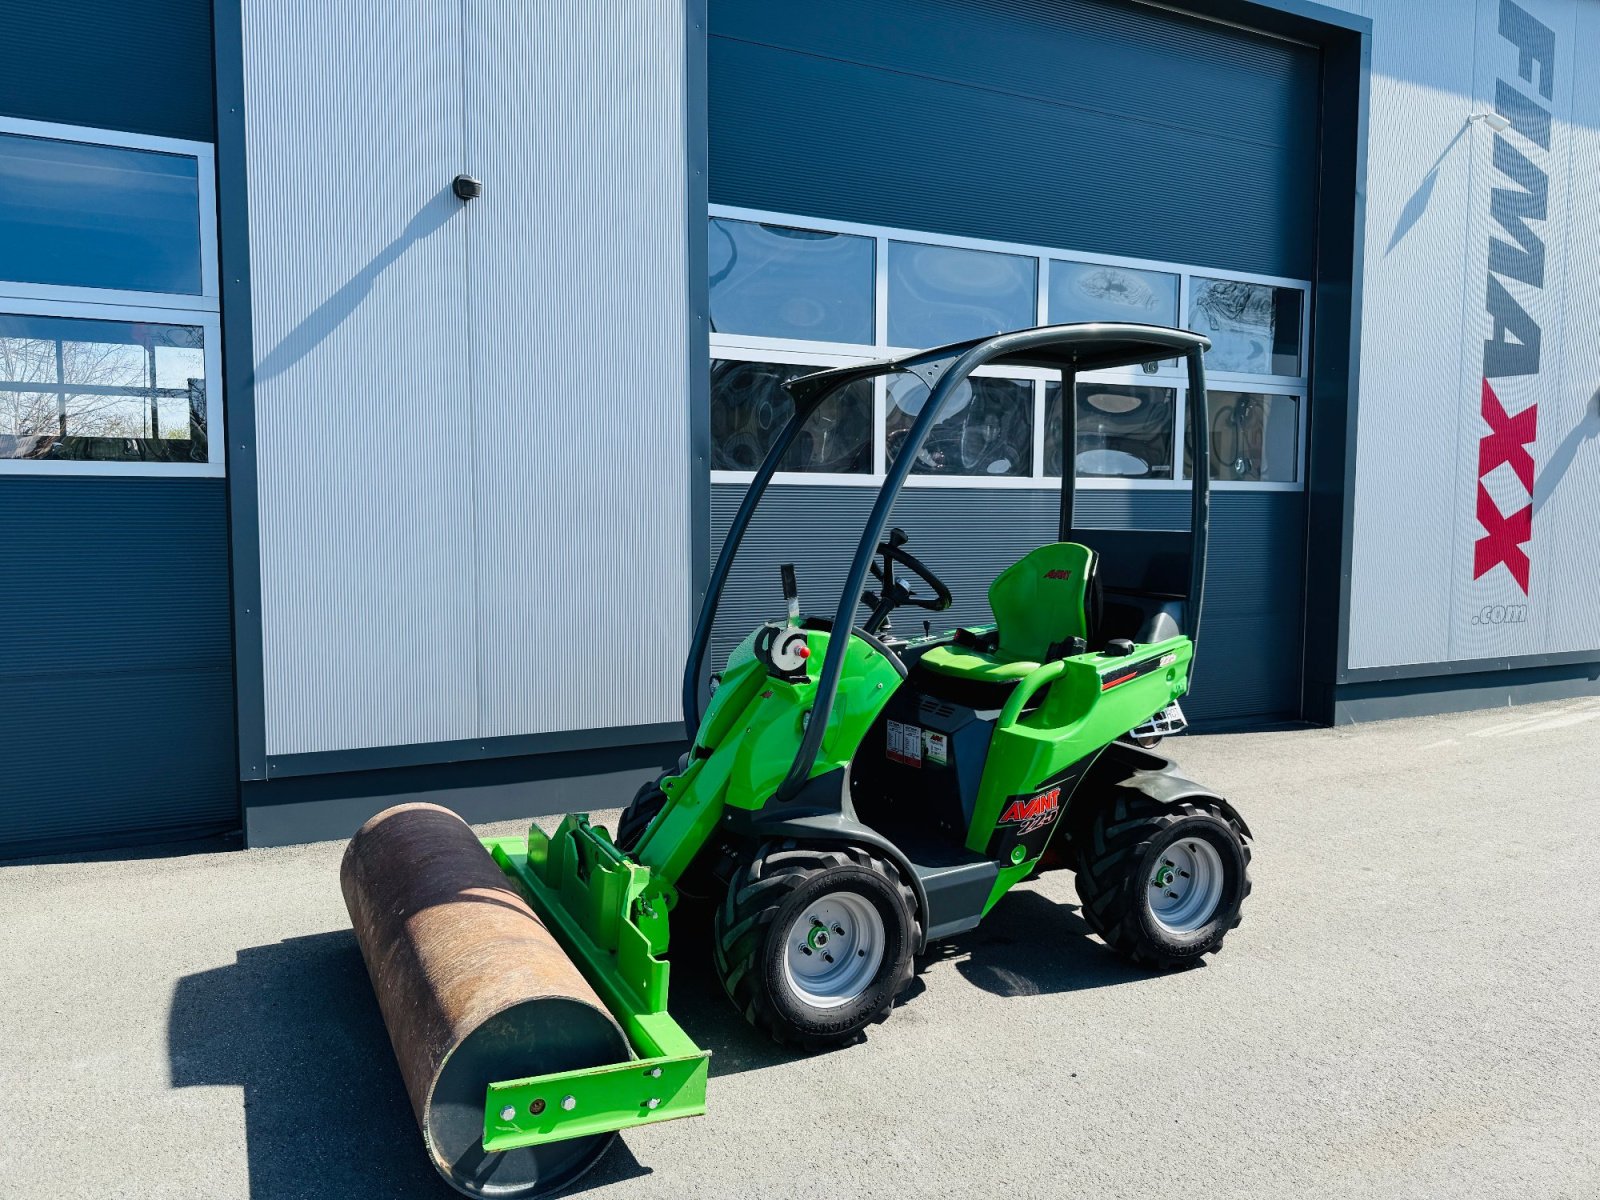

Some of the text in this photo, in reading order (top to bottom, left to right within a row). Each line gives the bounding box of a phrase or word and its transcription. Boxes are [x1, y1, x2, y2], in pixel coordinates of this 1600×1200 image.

[1473, 0, 1556, 598] FIMAXX
[1470, 604, 1528, 626] .com
[998, 786, 1061, 824] AVANT
